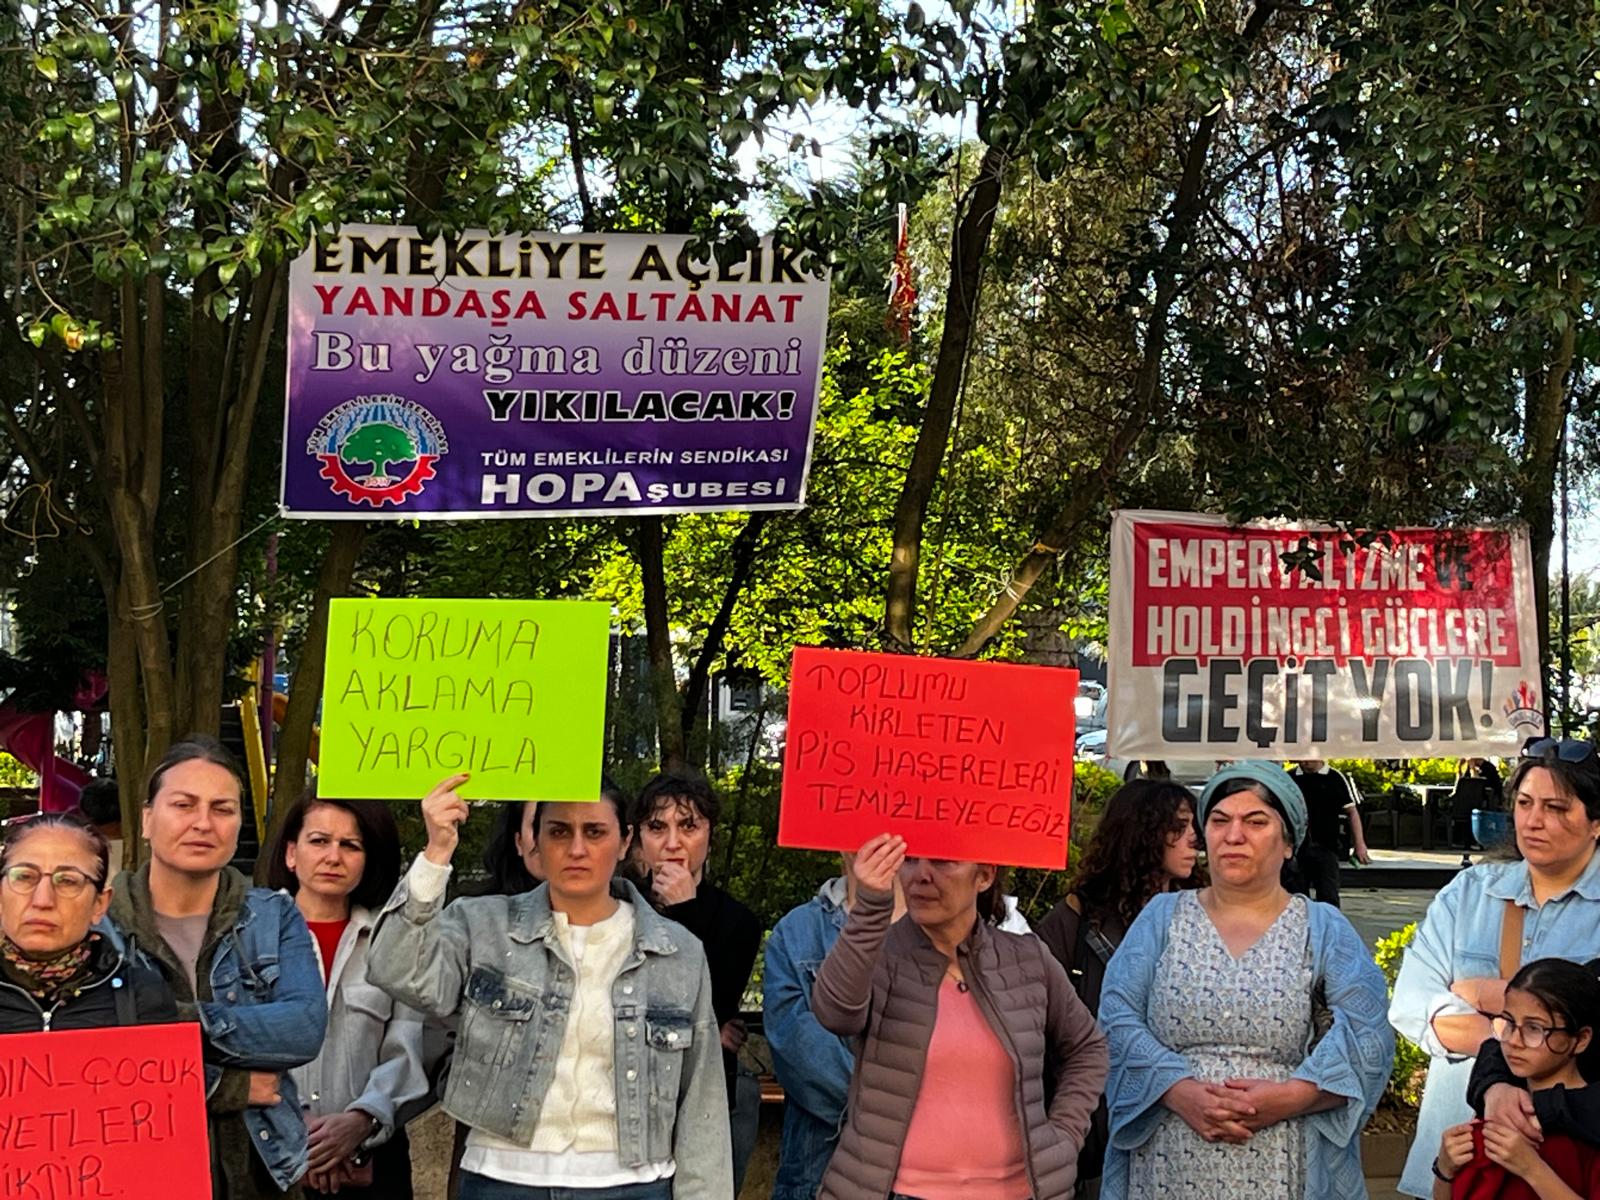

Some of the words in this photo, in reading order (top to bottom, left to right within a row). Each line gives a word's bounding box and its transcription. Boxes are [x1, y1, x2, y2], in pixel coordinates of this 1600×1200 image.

[313, 285, 547, 327] YANDAŞA
[567, 291, 804, 323] SALTANAT
[311, 331, 393, 373] Bu
[414, 334, 601, 384] yağma
[621, 337, 802, 377] düzeni
[483, 390, 796, 422] YIKILACAK!
[481, 450, 526, 466] TÜM
[534, 448, 673, 466] EMEKLİLERİN
[680, 447, 788, 463] SENDİKASI
[481, 472, 642, 504] HOPA
[646, 478, 786, 503] ŞUBESİ
[351, 608, 540, 667] KORUMA
[1147, 596, 1350, 656] HOLDİNGCİ
[1361, 597, 1508, 657] GÜÇLERE
[340, 669, 533, 716] AKLAMA
[805, 664, 967, 702] TOPLUMU
[1348, 658, 1493, 742] YOK!
[350, 722, 536, 775] YARGILA
[850, 704, 1004, 745] KİRLETEN
[795, 729, 855, 776] PİS
[872, 745, 1060, 794] HAŞERELERİ
[806, 783, 1066, 839] TEMİZLEYECEĞİZ
